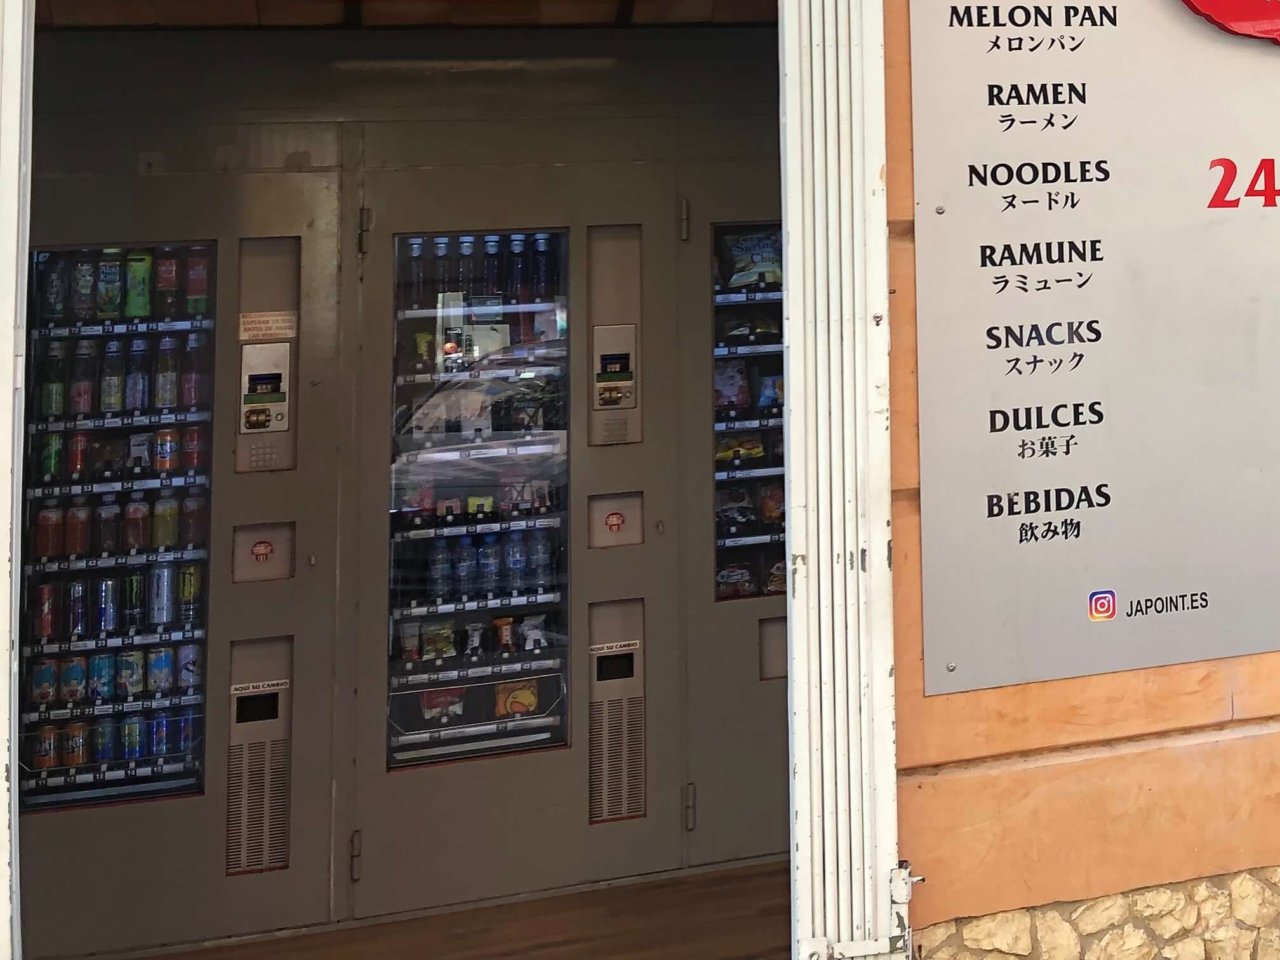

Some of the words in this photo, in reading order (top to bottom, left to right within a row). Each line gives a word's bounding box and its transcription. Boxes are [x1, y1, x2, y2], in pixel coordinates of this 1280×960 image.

[949, 6, 1052, 27] MELON
[1064, 6, 1117, 26] PAN
[987, 35, 1084, 53] メロンパン
[988, 83, 1086, 105] RAMEN
[999, 113, 1077, 132] ラーメン
[968, 160, 1110, 186] NOODLES
[1002, 192, 1080, 212] ヌードル
[980, 240, 1103, 267] RAMUNE
[993, 272, 1092, 294] ラミューン
[986, 320, 1101, 349] SNACKS
[1006, 352, 1084, 375] スナック
[989, 402, 1103, 433] DULCES
[1018, 434, 1078, 459] お菓子
[987, 484, 1110, 518] BEBIDAS
[1019, 519, 1080, 544] 飲み物
[1126, 592, 1208, 617] JAPOINT.ES
